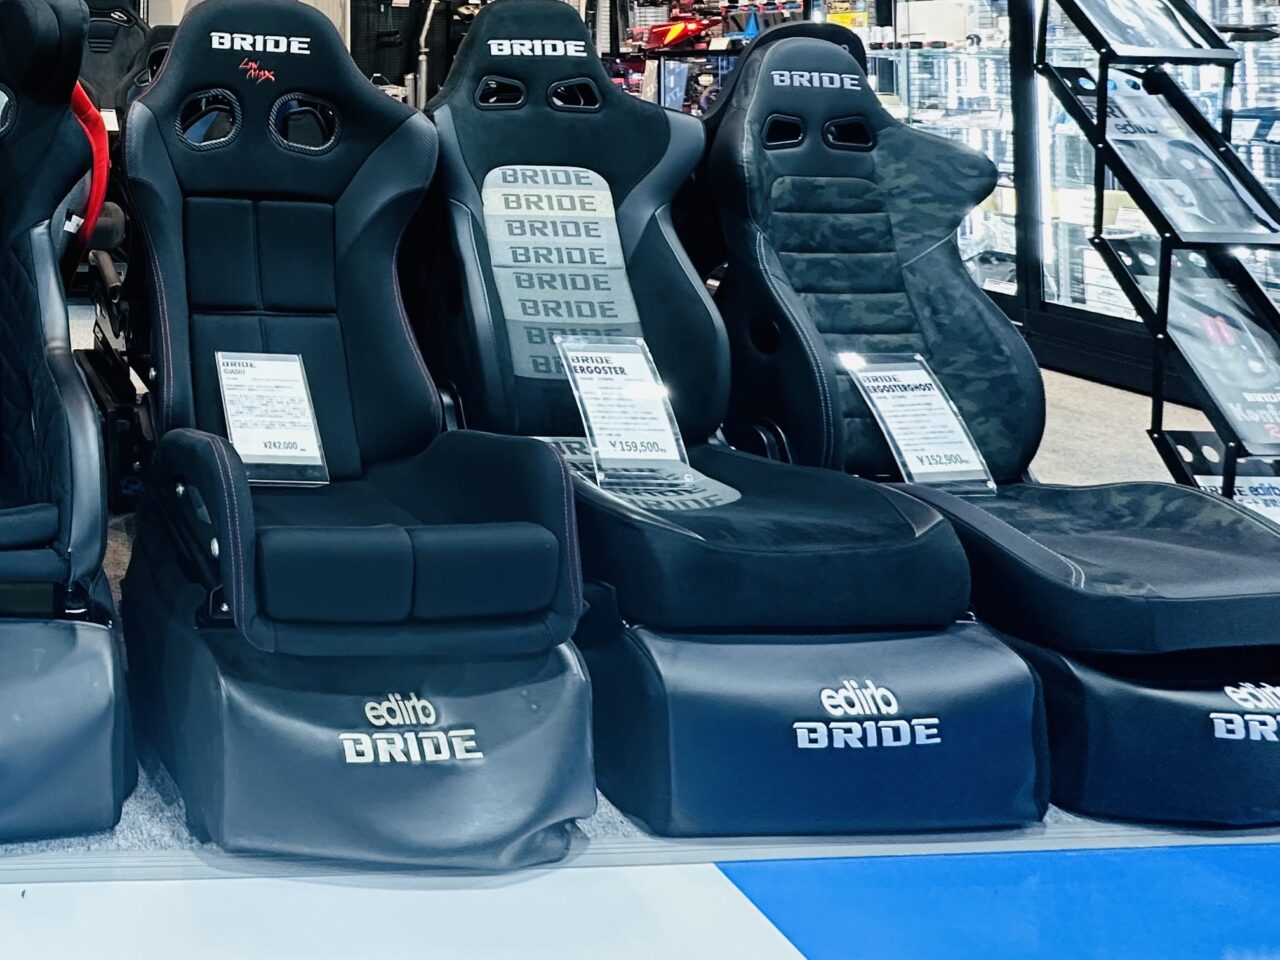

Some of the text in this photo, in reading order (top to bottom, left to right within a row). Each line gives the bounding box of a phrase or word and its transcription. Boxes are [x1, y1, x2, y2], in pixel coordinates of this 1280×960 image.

[210, 31, 311, 55] BRIDE
[487, 39, 587, 57] BRIDE
[771, 69, 862, 91] BRIDE
[501, 168, 593, 186] BRIDE
[502, 193, 597, 212] BRIDE
[505, 219, 602, 238] BRIDE
[509, 246, 607, 265] BRIDE
[512, 271, 612, 291] BRIDE
[518, 298, 618, 319] BRIDE
[574, 365, 627, 376] ERGOSTER
[820, 679, 899, 718] edirb
[364, 691, 437, 727] edirb
[792, 717, 942, 749] BRIDE
[337, 728, 484, 764] BRIDE
